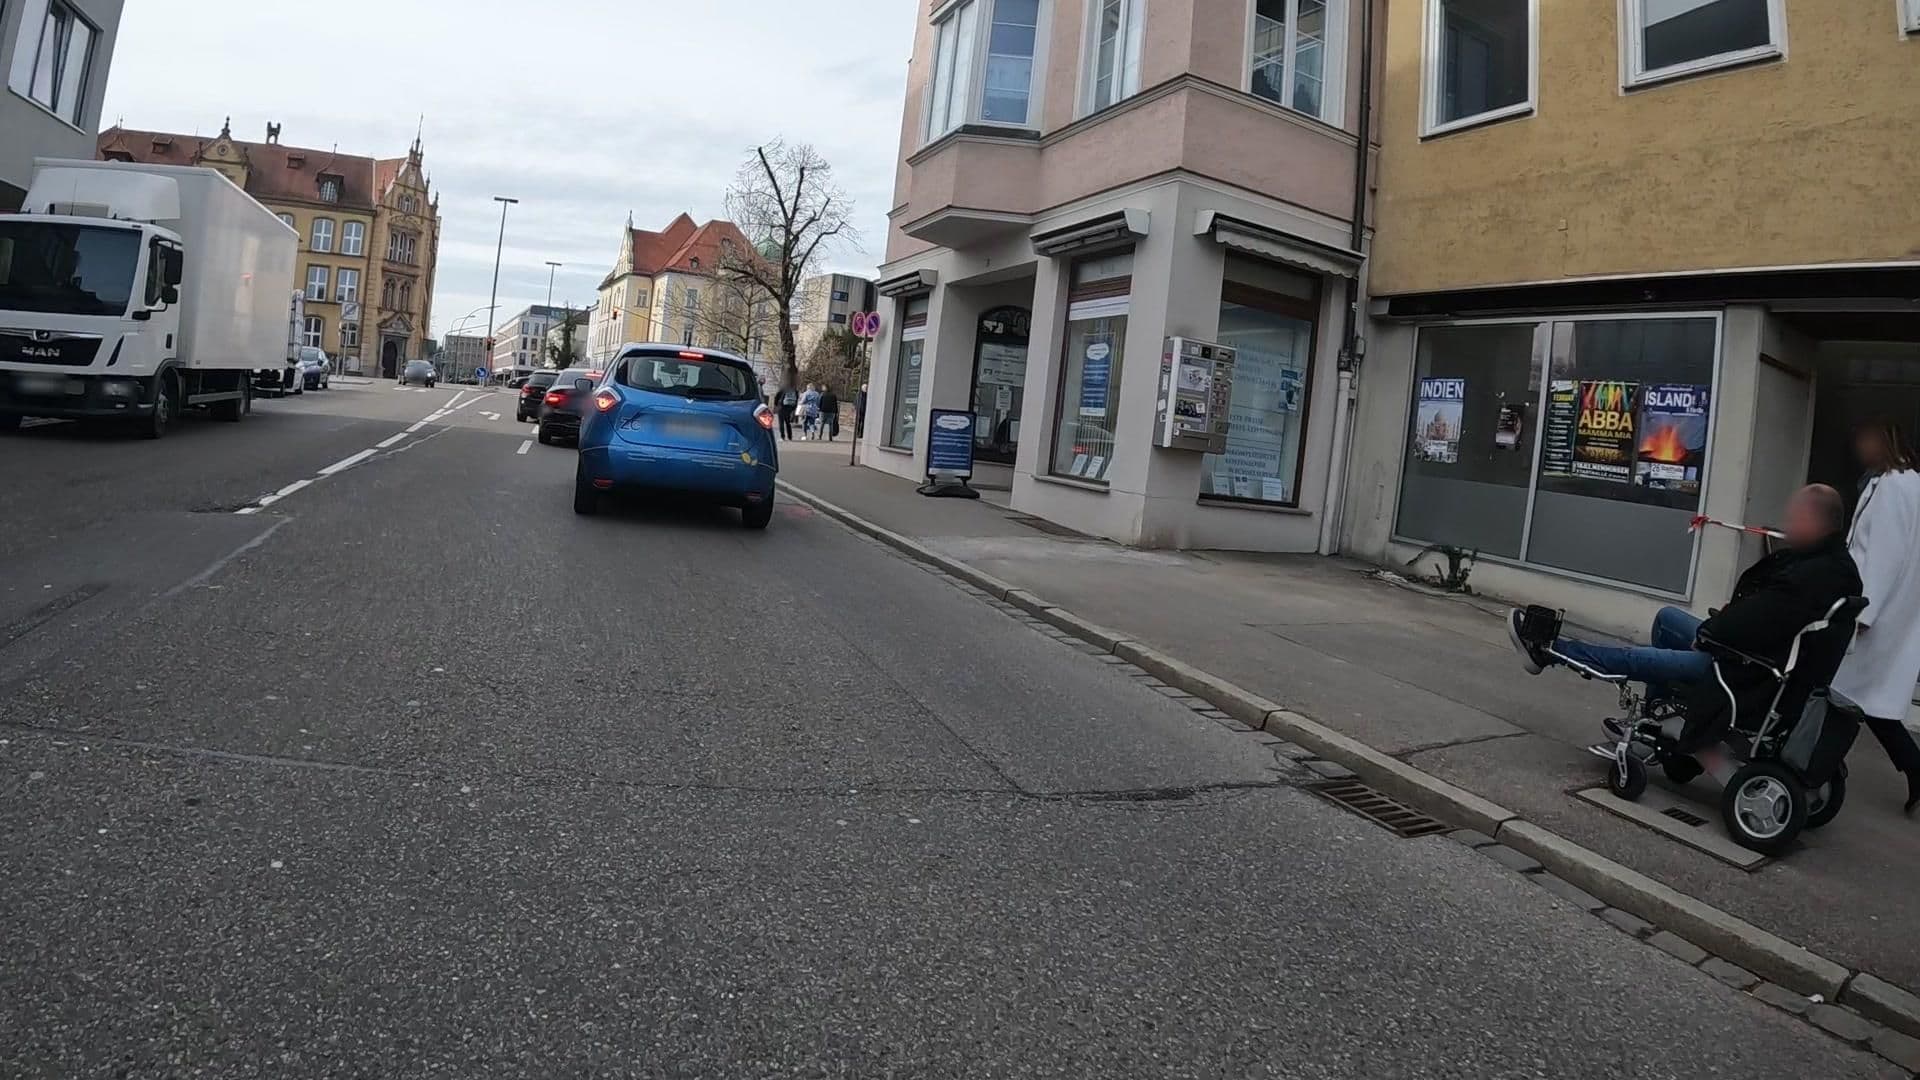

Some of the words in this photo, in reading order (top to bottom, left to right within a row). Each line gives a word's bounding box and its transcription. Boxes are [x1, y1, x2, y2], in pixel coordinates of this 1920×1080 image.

[22, 346, 60, 357] MAN
[1420, 381, 1465, 398] INDIEN
[1644, 390, 1692, 407] ISLAND
[1578, 409, 1634, 432] ABBA
[1578, 428, 1613, 438] MAMMA
[1613, 431, 1632, 440] MIA
